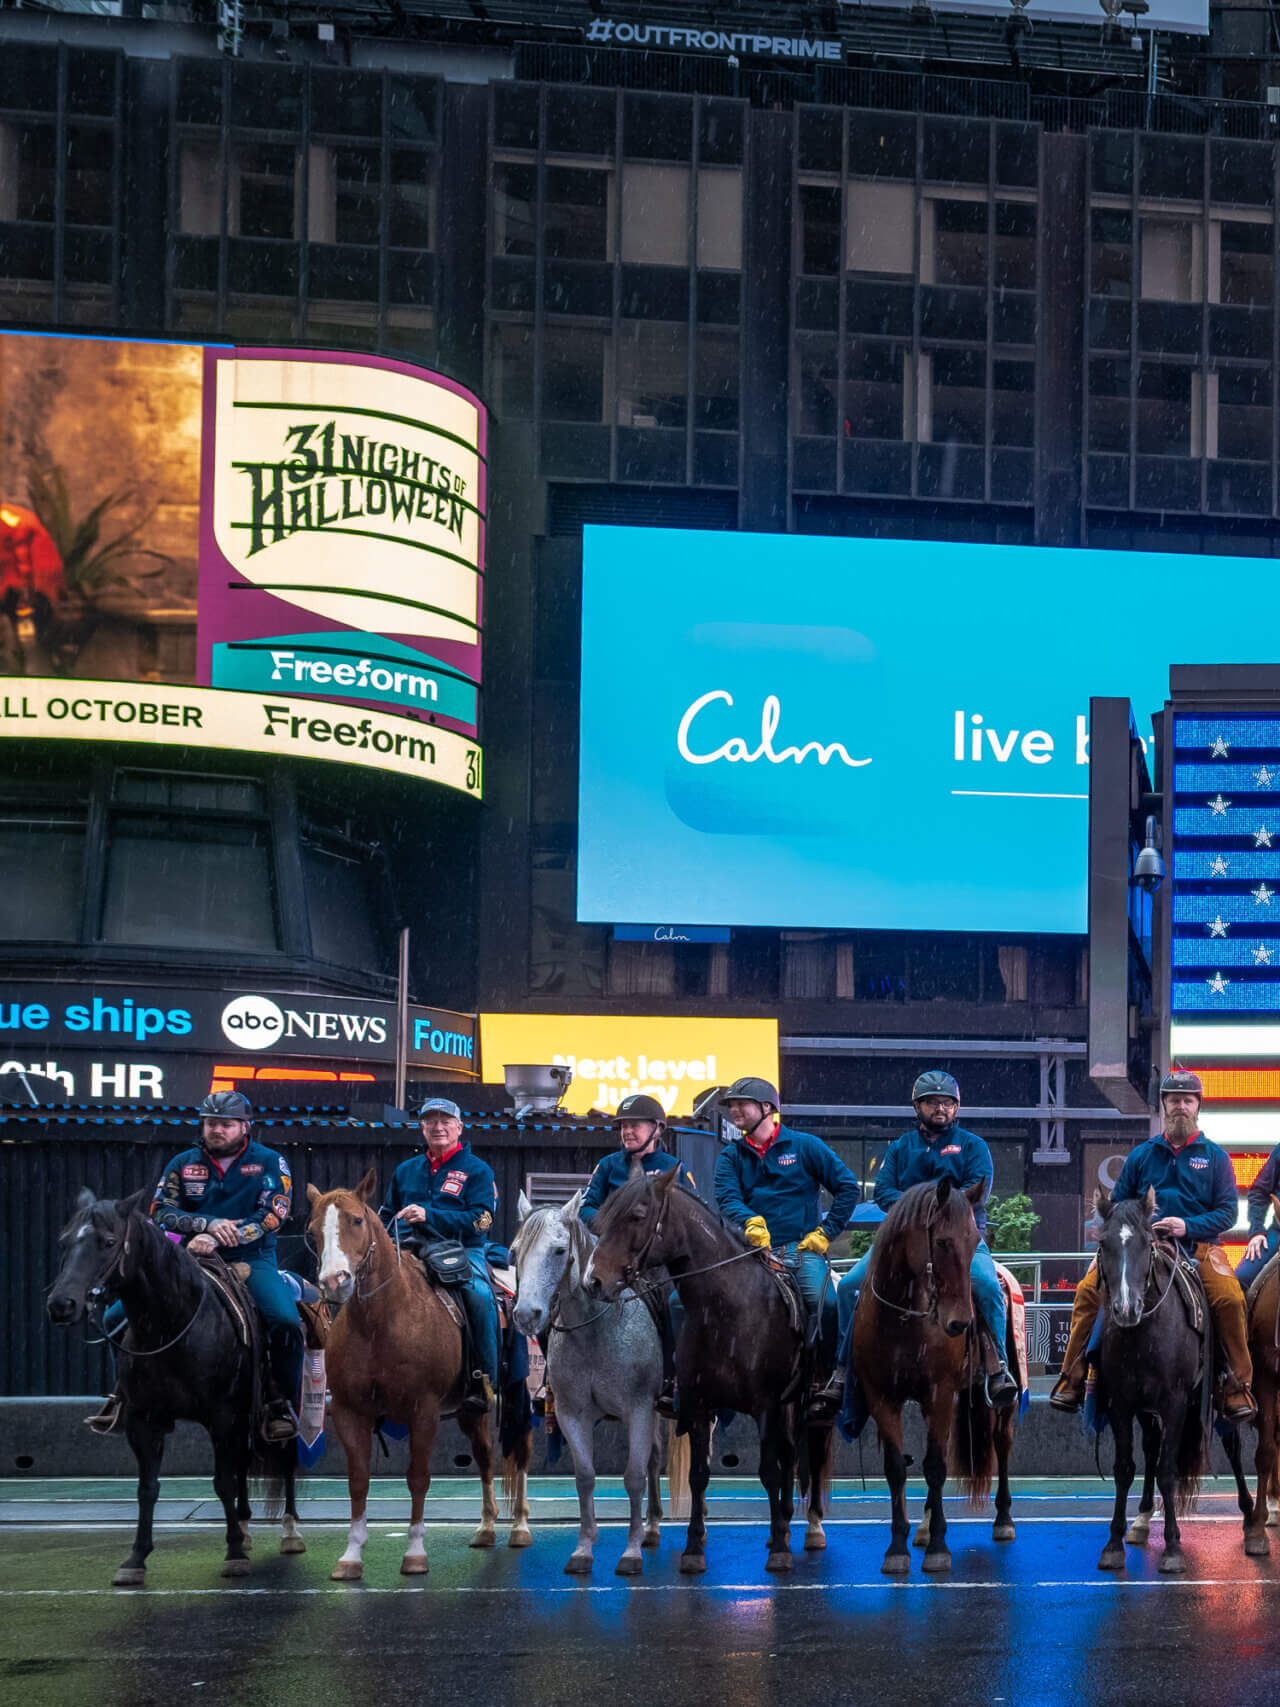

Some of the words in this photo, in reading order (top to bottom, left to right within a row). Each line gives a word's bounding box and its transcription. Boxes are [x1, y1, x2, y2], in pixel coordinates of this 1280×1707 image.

[586, 18, 842, 60] #OUTFRONTPRIME
[284, 420, 337, 484] 31
[339, 433, 452, 493] NIGHTS
[454, 476, 467, 495] OF
[240, 462, 466, 559] HALLOWEEN
[270, 651, 438, 701] Freeform
[0, 697, 37, 718] LL
[47, 698, 203, 728] OCTOBER
[263, 704, 436, 764] Freeform
[677, 689, 873, 767] Calm
[954, 710, 1054, 764] live
[654, 926, 691, 941] Calm
[64, 997, 193, 1041] ships
[228, 1011, 279, 1031] abc
[284, 1010, 387, 1044] NEWS
[91, 1063, 164, 1098] HR
[638, 1054, 717, 1080] level
